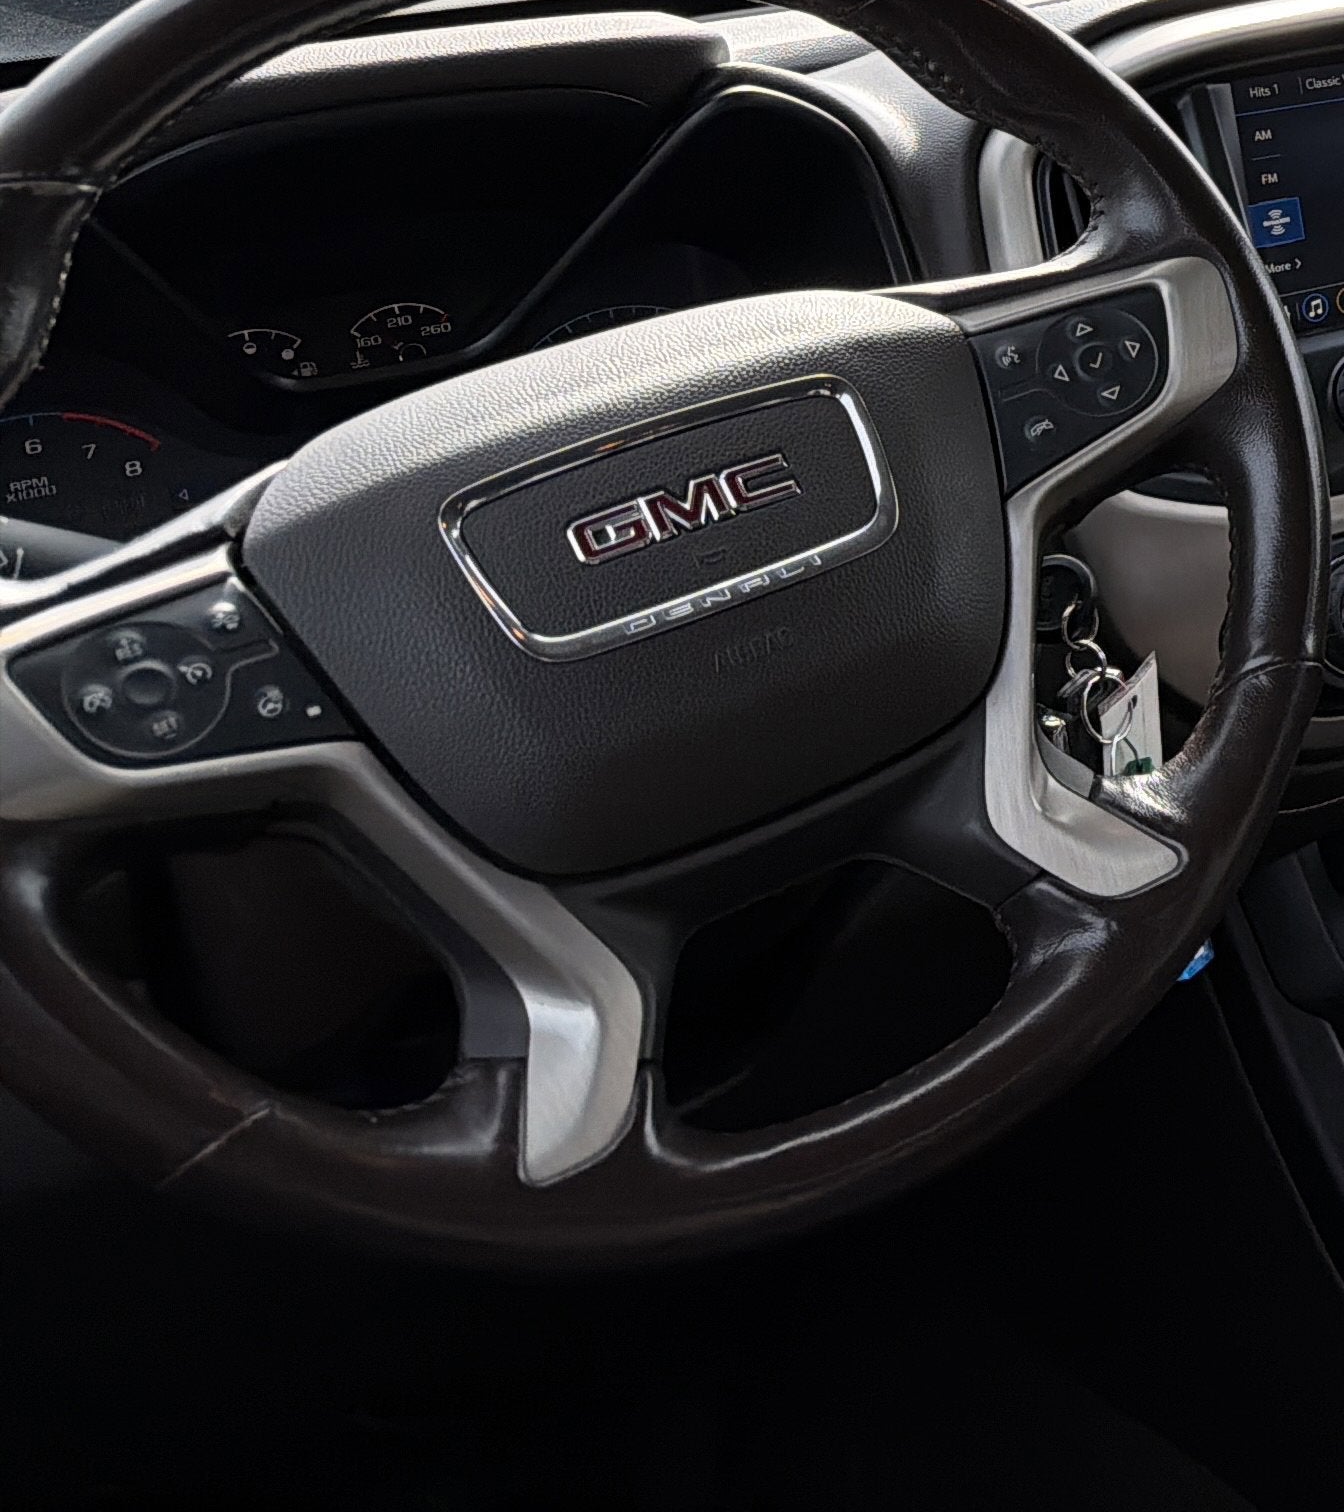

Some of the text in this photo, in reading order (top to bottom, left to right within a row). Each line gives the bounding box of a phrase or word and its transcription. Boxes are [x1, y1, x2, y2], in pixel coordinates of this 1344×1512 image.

[1305, 76, 1341, 90] Classic
[1249, 86, 1271, 99] Hits
[1254, 129, 1272, 142] AM
[1261, 172, 1279, 185] FM
[1265, 261, 1292, 274] More
[386, 314, 412, 328] 210
[420, 322, 451, 337] 260
[357, 335, 382, 348] 160
[24, 438, 42, 455] 6
[81, 443, 97, 460] 7
[124, 460, 143, 477] 8
[9, 476, 49, 493] RPM
[566, 452, 803, 565] GMC
[622, 554, 823, 635] DENALI
